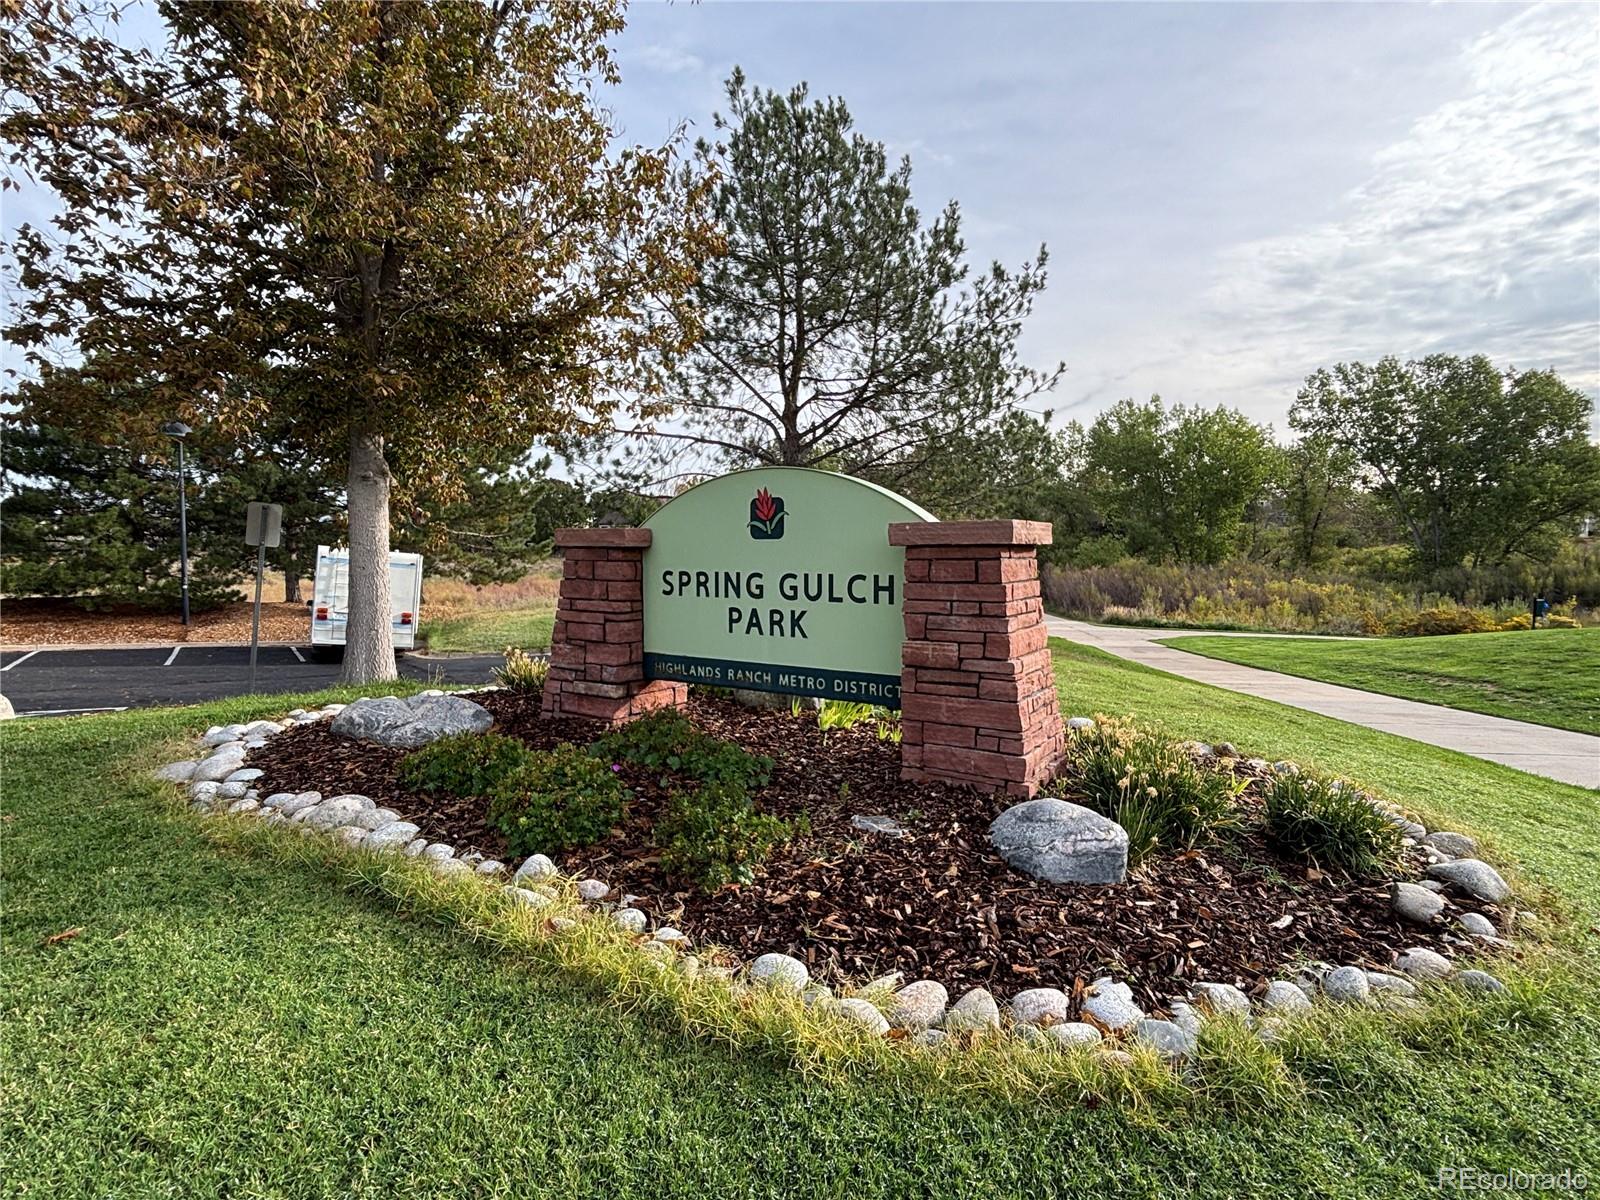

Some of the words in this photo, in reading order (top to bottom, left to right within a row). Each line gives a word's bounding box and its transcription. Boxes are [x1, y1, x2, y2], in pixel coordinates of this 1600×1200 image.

[662, 570, 764, 599] SPRING
[779, 572, 895, 605] GULCH
[728, 607, 809, 639] PARK
[654, 662, 721, 679] HIGHLANDS
[727, 669, 772, 684] RANCH
[779, 673, 826, 690] METRO
